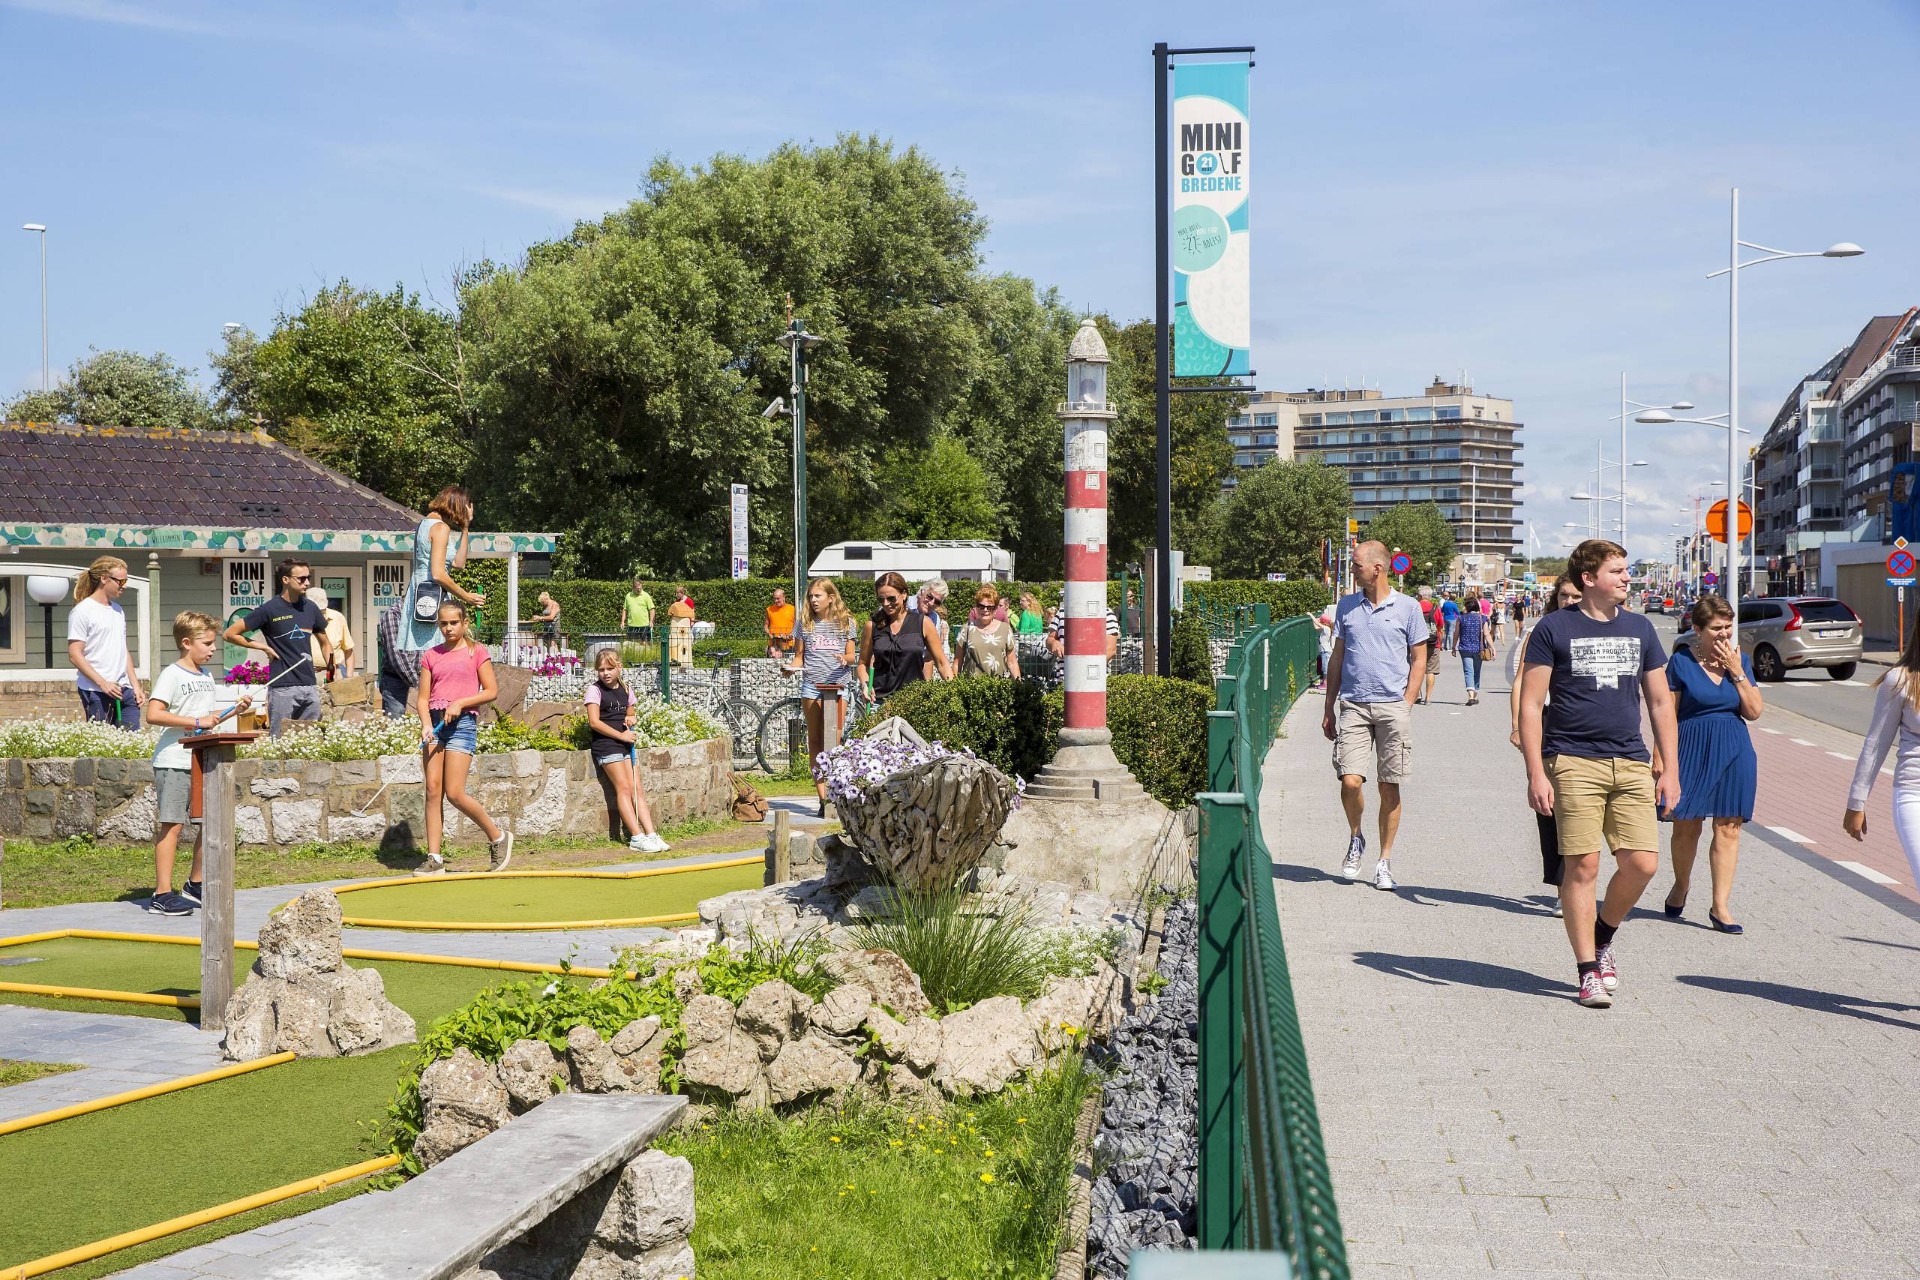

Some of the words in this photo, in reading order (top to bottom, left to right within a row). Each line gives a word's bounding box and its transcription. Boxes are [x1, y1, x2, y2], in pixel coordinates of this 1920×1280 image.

[1181, 122, 1242, 152] MINI
[1201, 157, 1213, 168] 21
[1181, 176, 1241, 193] BREDENE
[230, 562, 264, 580] MINI
[374, 565, 404, 582] MINI
[323, 583, 346, 591] KASSA
[230, 596, 264, 606] BREDENE
[374, 597, 401, 606] BREDEN
